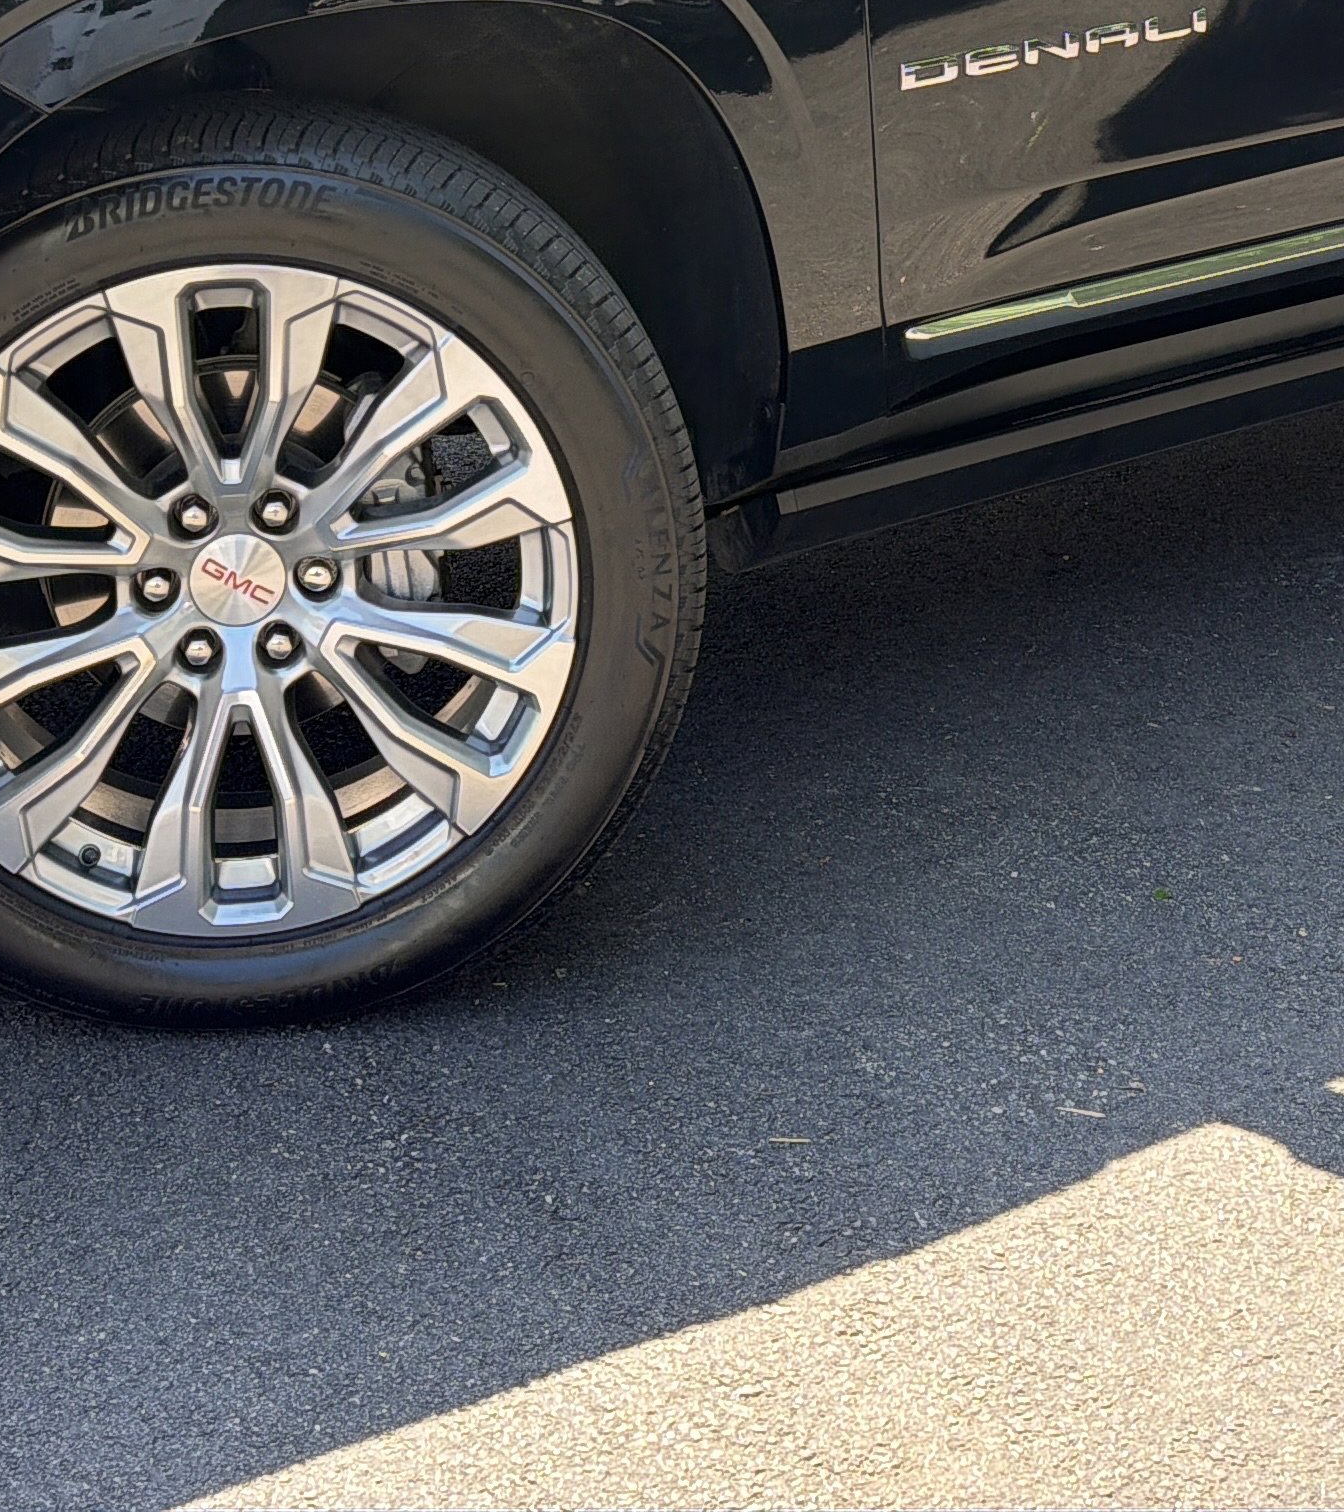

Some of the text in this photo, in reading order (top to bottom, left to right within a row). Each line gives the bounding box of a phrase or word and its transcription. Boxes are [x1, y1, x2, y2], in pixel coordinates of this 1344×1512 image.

[900, 6, 1208, 92] DENALI
[62, 175, 336, 243] BRIDGESTONE
[201, 557, 276, 606] GMC
